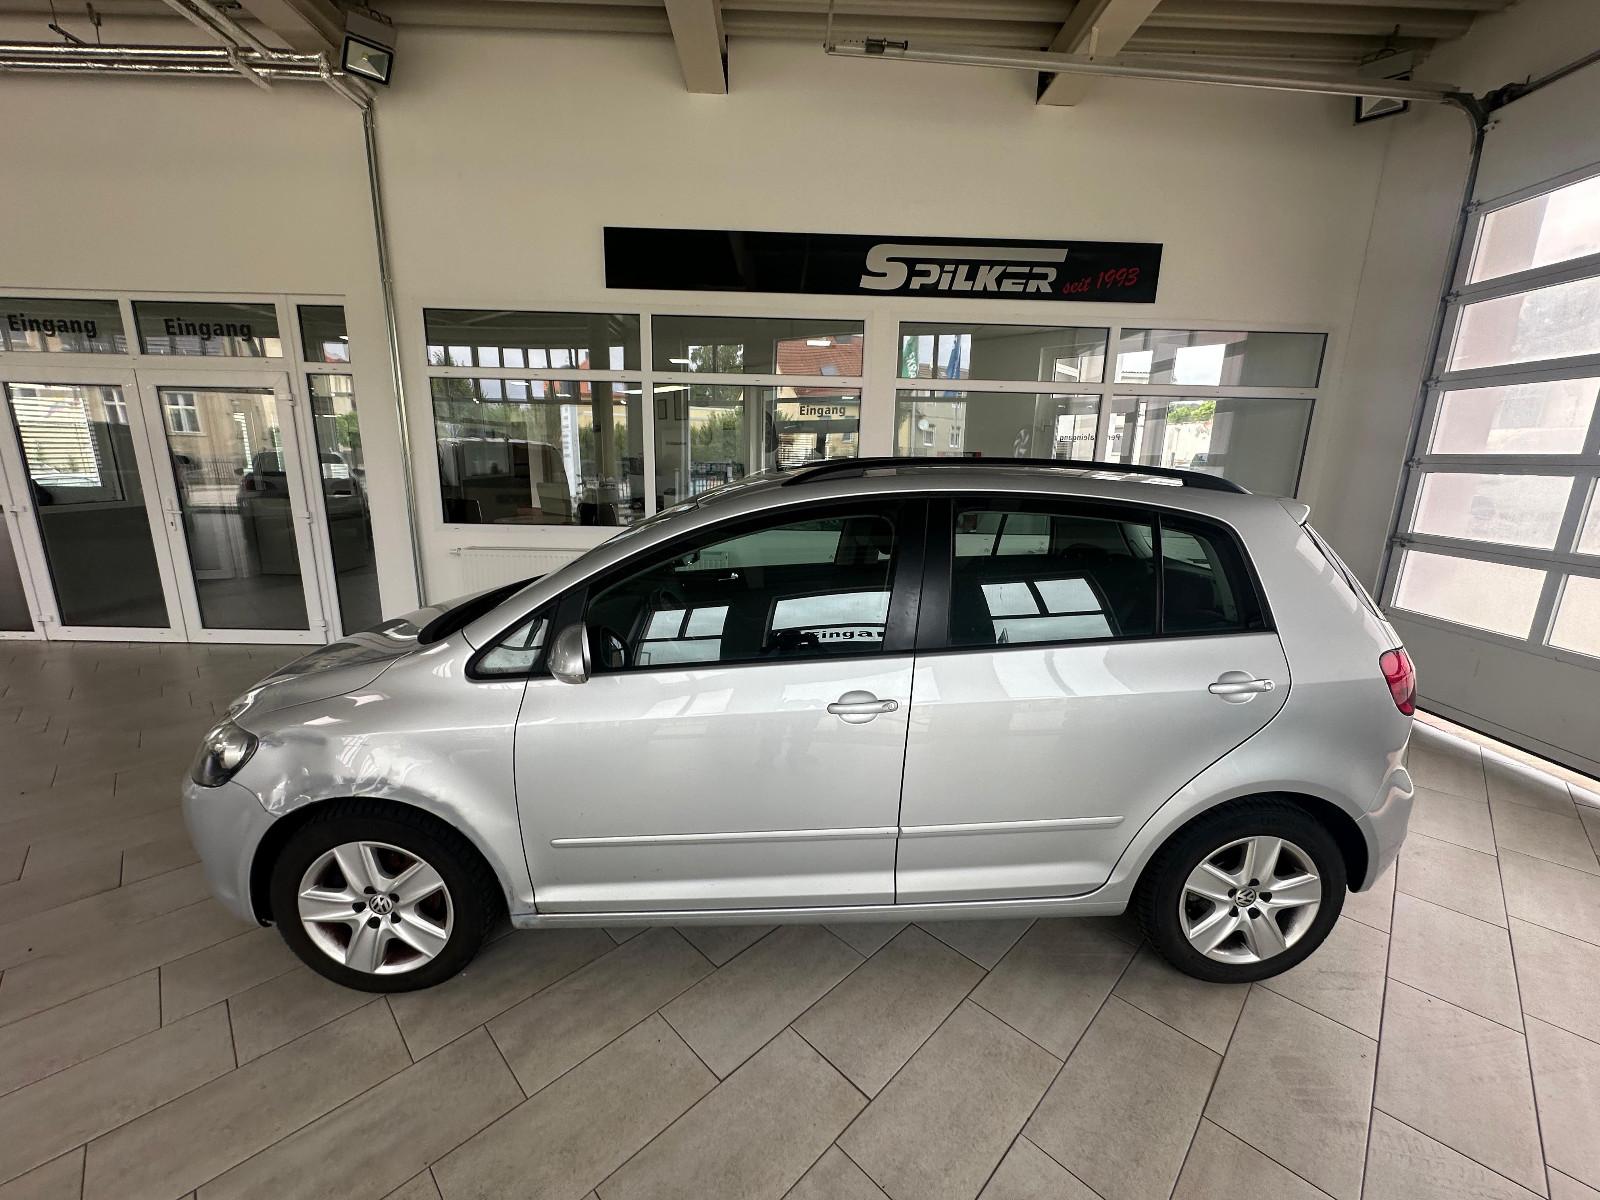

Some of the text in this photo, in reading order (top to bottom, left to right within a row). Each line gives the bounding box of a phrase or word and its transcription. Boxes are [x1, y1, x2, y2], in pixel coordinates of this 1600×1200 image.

[1063, 276, 1091, 294] seit
[1096, 266, 1140, 289] 1993
[7, 313, 97, 338] Eingang
[164, 317, 252, 342] Eingang
[799, 405, 846, 417] Eingang
